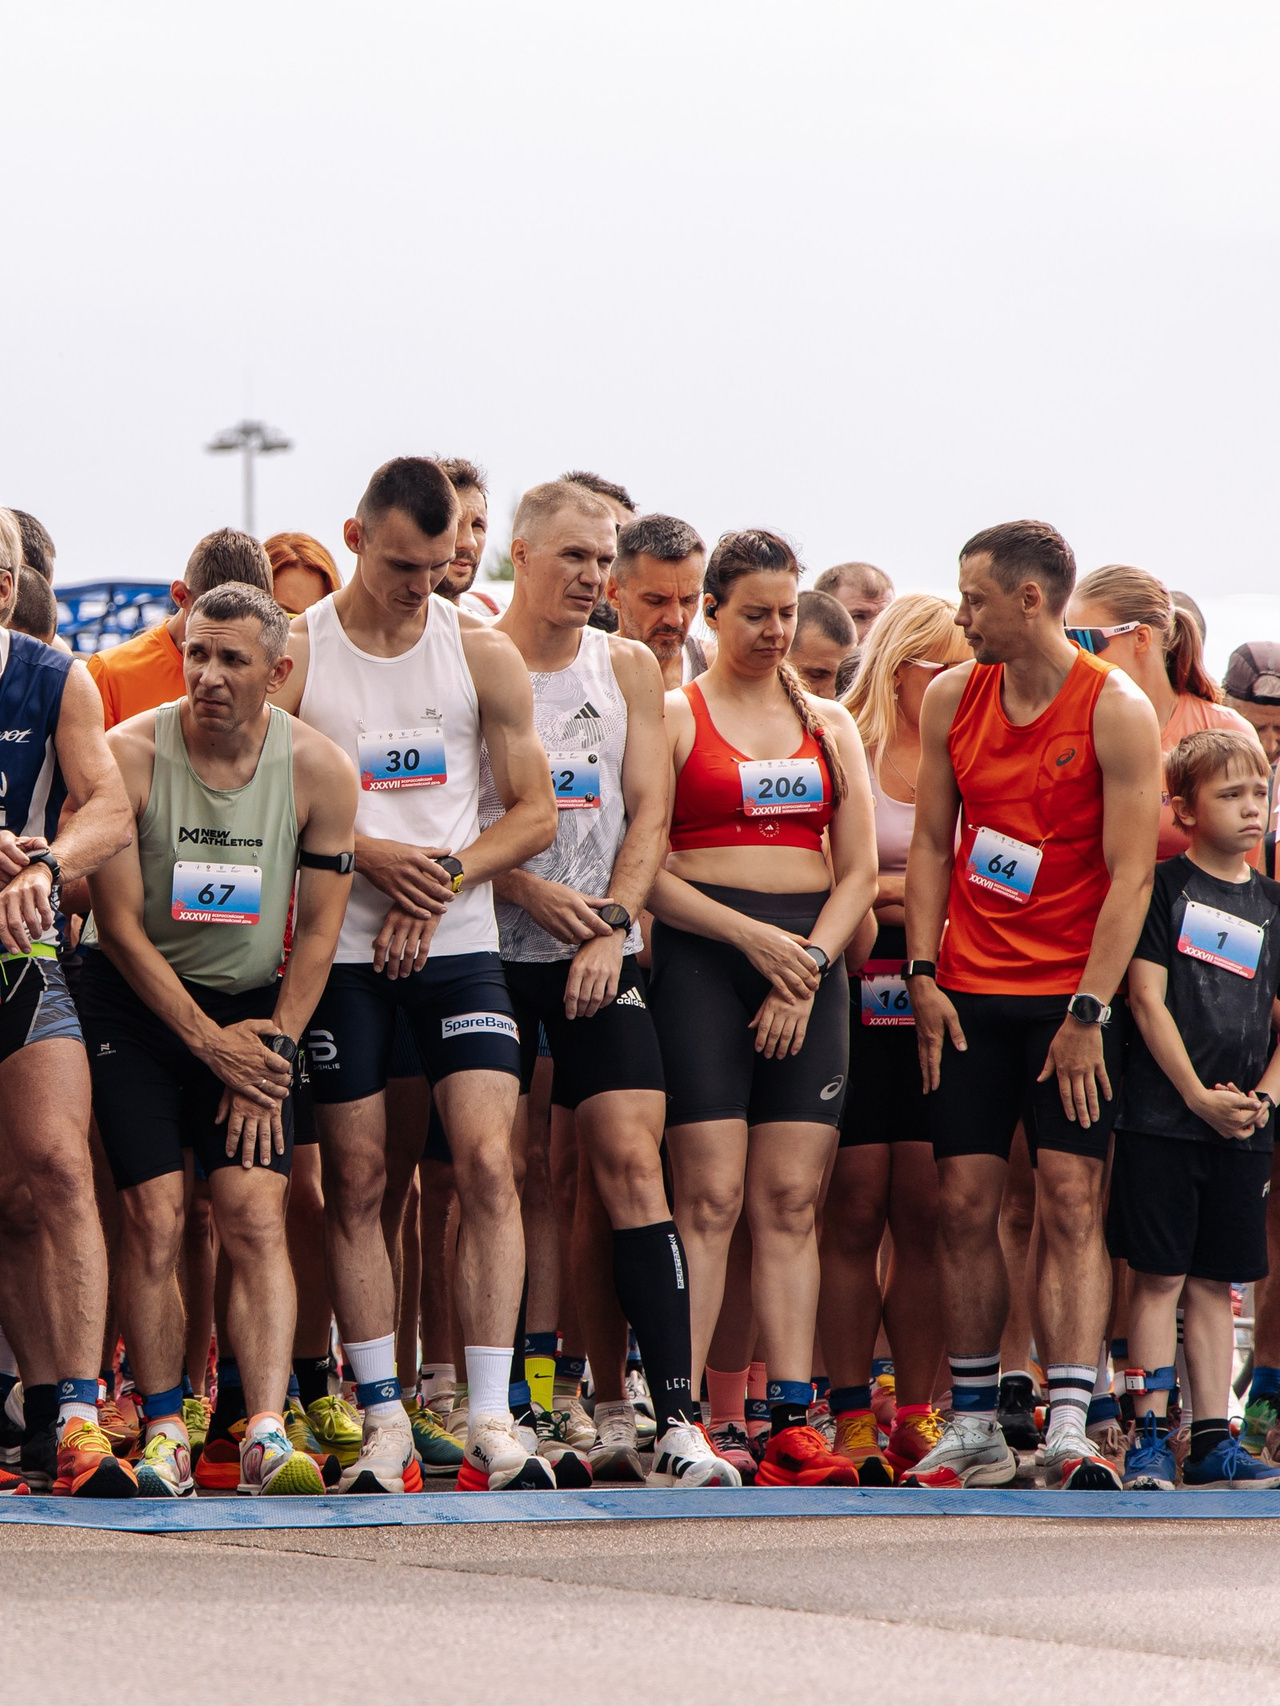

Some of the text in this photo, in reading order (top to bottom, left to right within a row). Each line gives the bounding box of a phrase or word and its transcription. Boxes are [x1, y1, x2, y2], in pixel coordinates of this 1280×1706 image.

[385, 748, 420, 773] 30
[370, 780, 401, 790] XXXVII
[551, 770, 575, 791] 2
[758, 776, 807, 799] 206
[751, 806, 782, 816] XXXVII
[201, 828, 231, 838] NEW
[200, 838, 264, 847] ATHLETICS
[988, 853, 1018, 880] 64
[969, 873, 994, 890] XXXVII
[197, 883, 236, 906] 67
[178, 911, 211, 921] XXXVII
[1217, 931, 1229, 950] 1
[1184, 945, 1214, 962] XXXVII
[444, 1016, 515, 1034] SpareBank
[869, 1017, 898, 1025] XXXVII
[666, 1378, 691, 1391] LEFT
